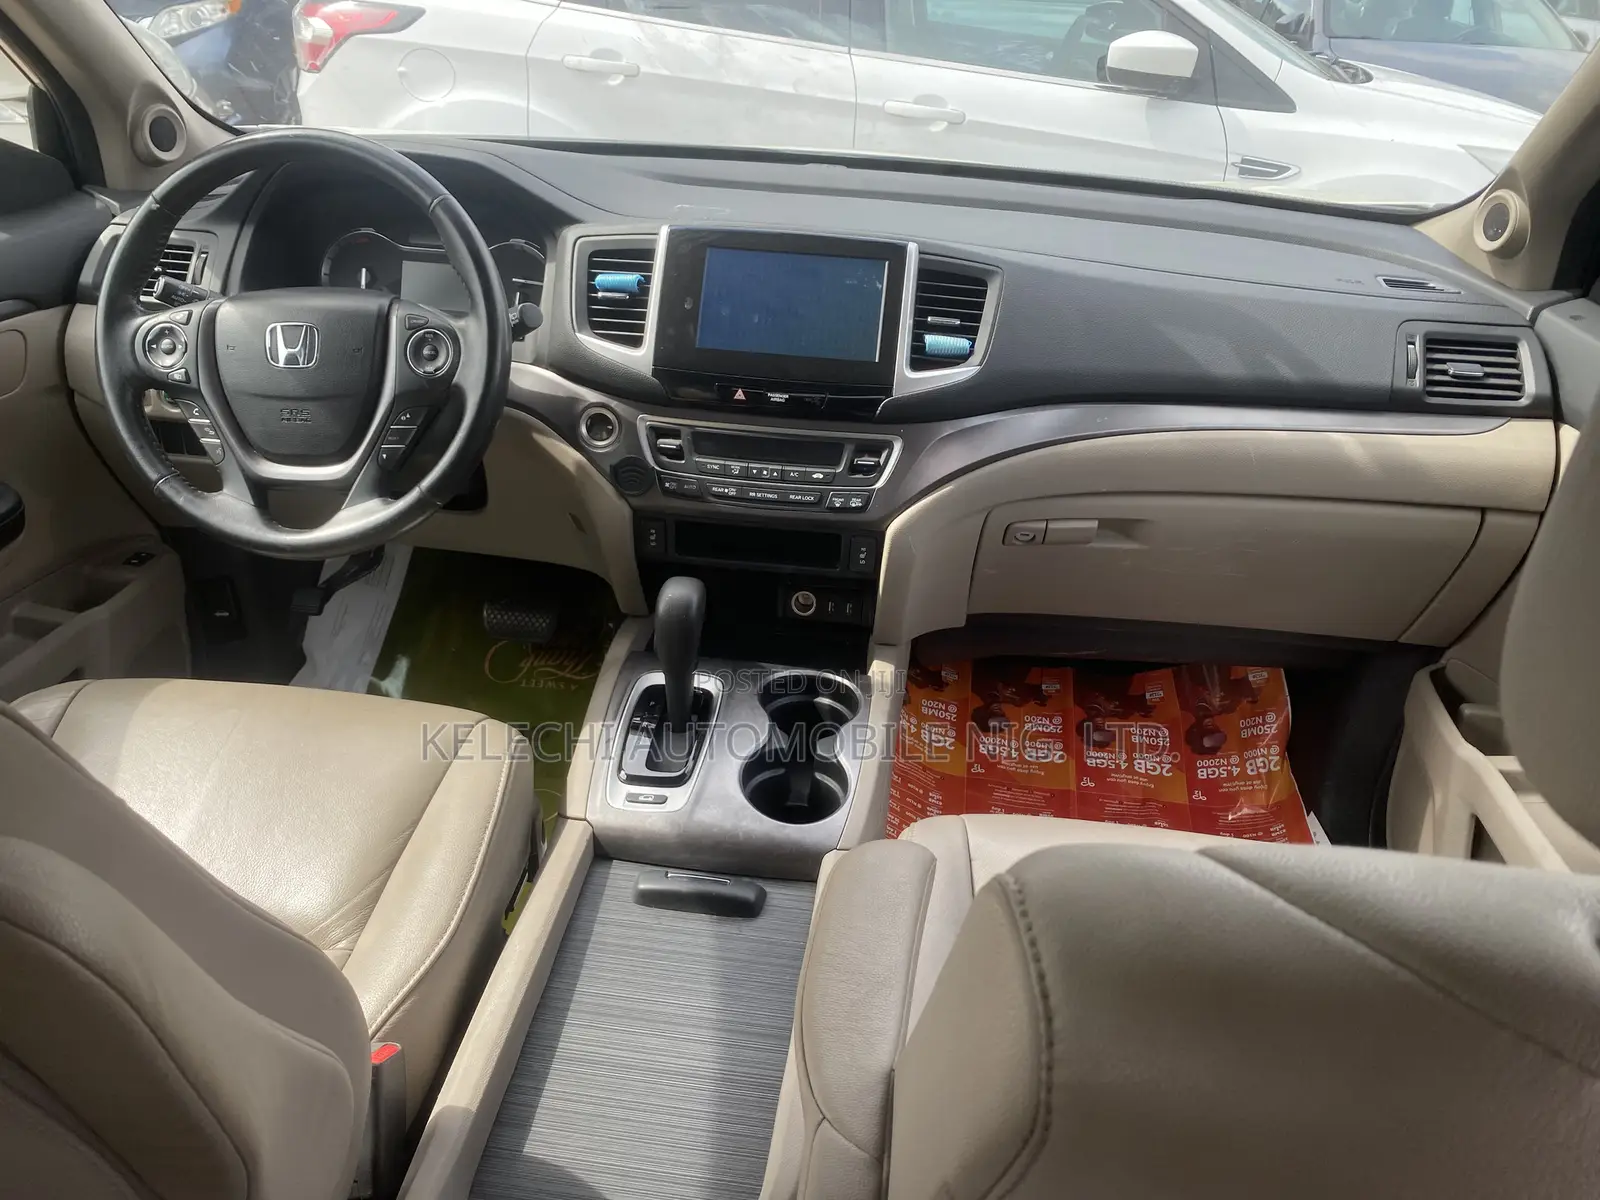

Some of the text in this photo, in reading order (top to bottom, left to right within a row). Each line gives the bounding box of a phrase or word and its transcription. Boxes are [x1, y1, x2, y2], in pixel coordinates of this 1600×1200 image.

[922, 699, 946, 710] N200
[922, 706, 957, 722] 250MB
[1024, 715, 1050, 724] N200
[1240, 715, 1263, 728] N200
[1024, 722, 1063, 734] 250MB
[1130, 727, 1156, 737] N200
[1240, 724, 1278, 738] 250MB
[920, 730, 956, 750] 2GB
[1132, 735, 1170, 746] 250MB
[979, 744, 1020, 759] 4.5GB
[1086, 750, 1116, 760] N2000
[1244, 747, 1268, 759] N1000
[1086, 758, 1129, 770] 4.5GB
[1134, 760, 1173, 777] 2GB
[1196, 758, 1228, 768] N2000
[1246, 755, 1281, 776] 2GB
[1197, 766, 1241, 779] 4.5GB
